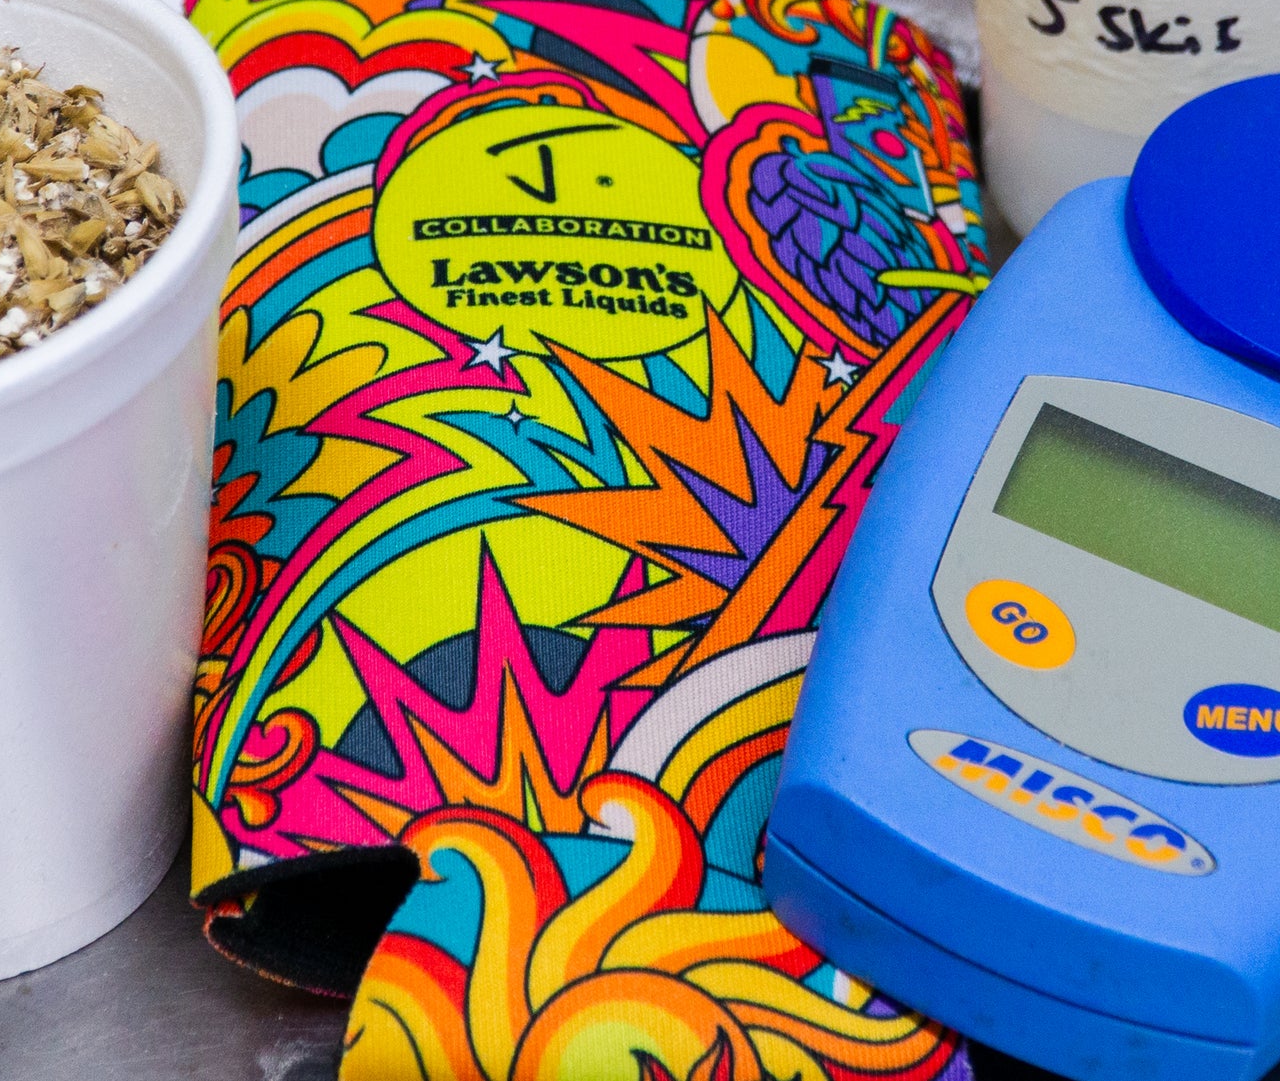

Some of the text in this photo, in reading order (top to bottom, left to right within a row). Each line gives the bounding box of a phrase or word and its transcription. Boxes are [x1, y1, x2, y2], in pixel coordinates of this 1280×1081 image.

[420, 219, 708, 248] COLLABORATION
[431, 258, 702, 298] Lawson's
[446, 288, 689, 320] Finest Liquids
[991, 600, 1049, 645] GO
